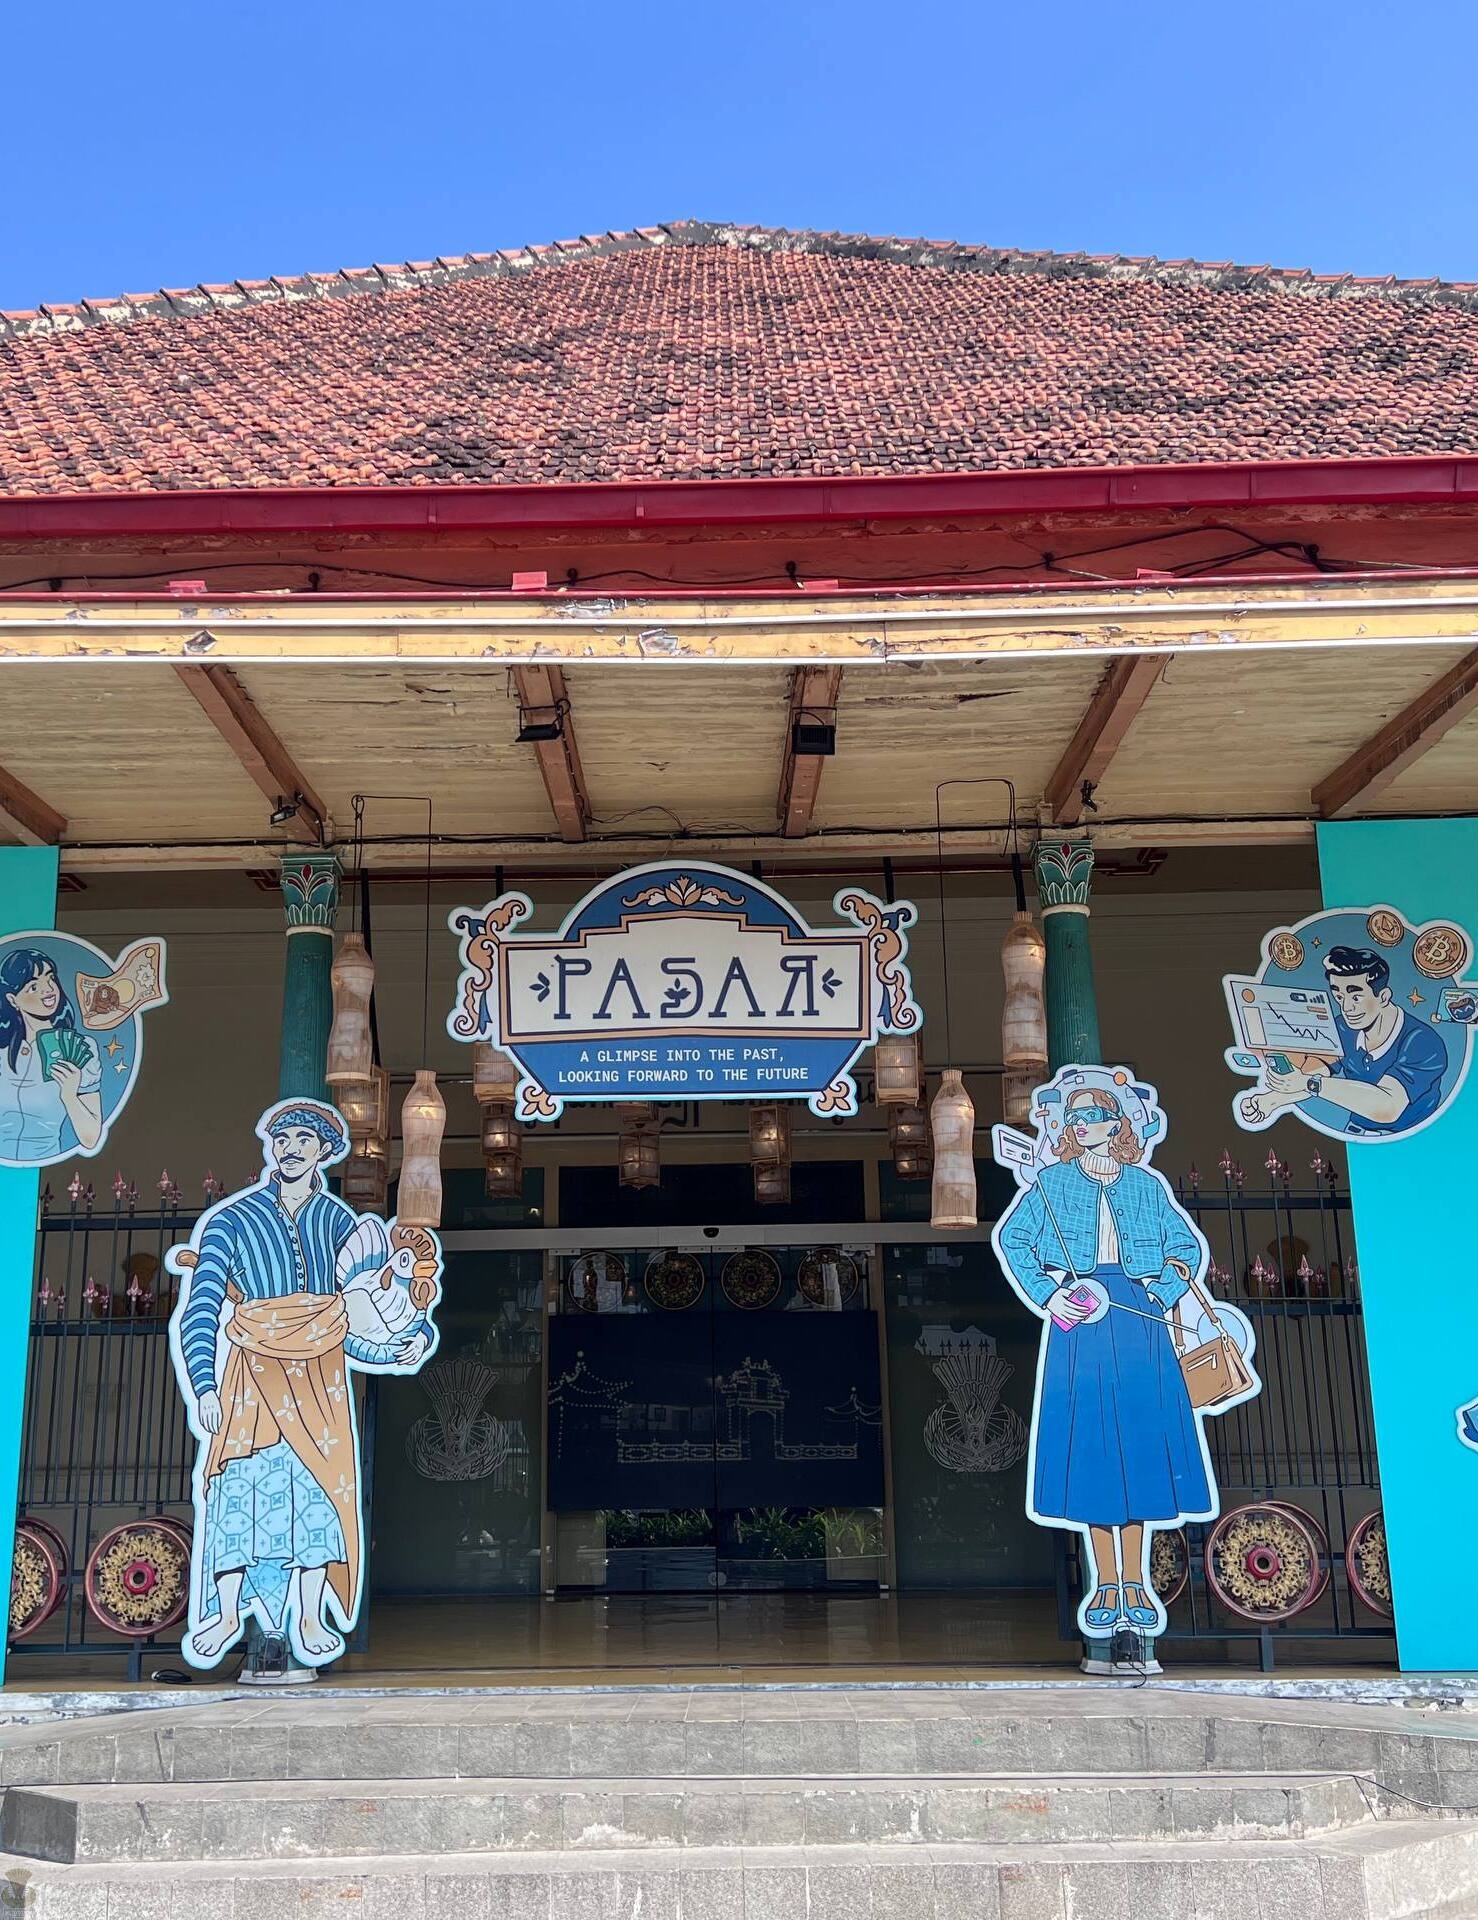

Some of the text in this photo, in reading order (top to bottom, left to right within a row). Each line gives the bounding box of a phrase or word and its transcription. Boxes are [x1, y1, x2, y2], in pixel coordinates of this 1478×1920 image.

[580, 1048, 784, 1062] A GLIMPSE INTO THE PAST,
[558, 1068, 809, 1082] LOOKING FORWARD TO THE FUTURE
